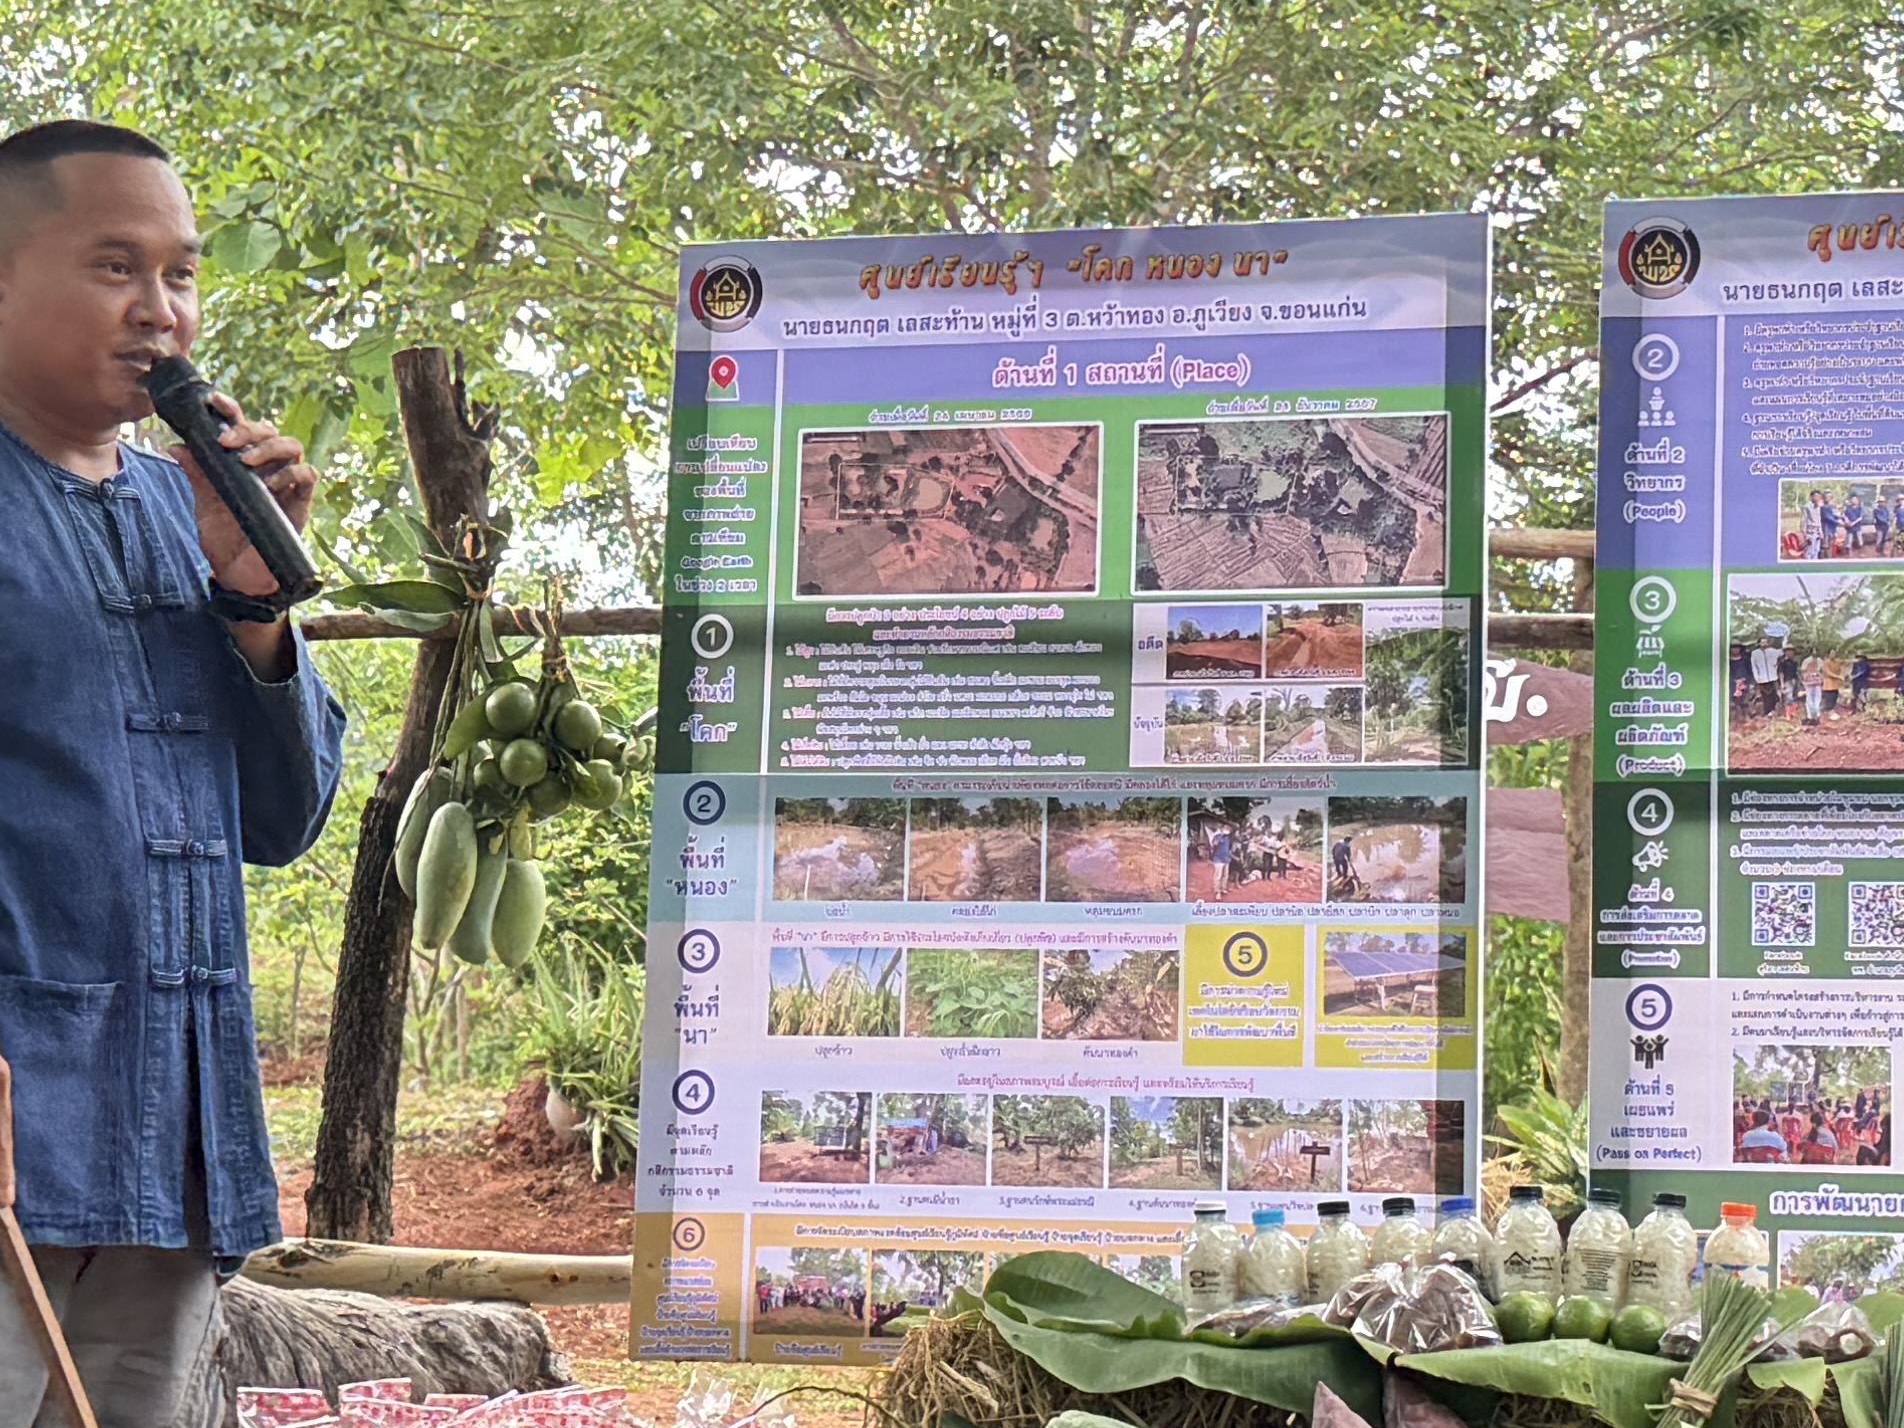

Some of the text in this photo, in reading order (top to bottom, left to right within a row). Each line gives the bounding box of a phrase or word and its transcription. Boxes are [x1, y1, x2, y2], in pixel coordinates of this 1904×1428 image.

[1144, 251, 1223, 280] หนอง
[1722, 280, 1844, 304] นายธนกฤต
[782, 293, 1368, 341] นายธนกฤต เลสะท้าน หมู่ที่ 3 ต.หว้าทอง อ.ภูเวียง จ.ขอนแก่น
[993, 342, 1252, 388] ด้านที่ 1 สถานที่ (Place)
[1625, 438, 1686, 463] ด้านที่ 2
[1624, 471, 1686, 491] วิทยากร
[1623, 499, 1686, 524] (People)
[686, 665, 735, 703] พื้นที่
[1622, 662, 1683, 689] ด้านที่ 3
[1609, 696, 1695, 718] ผลผลิตและ
[1615, 722, 1689, 746] ผลิตภัณฑ์
[1615, 752, 1686, 779] (Product)
[679, 835, 726, 870] พื้นที่
[673, 983, 721, 1019] พื้นที่
[1623, 1073, 1675, 1097] ด้านที่ 5
[1623, 1100, 1676, 1118] เผยแพร่
[1609, 1125, 1689, 1139] และขยายผล
[1595, 1143, 1703, 1164] (Pass on Perfect)
